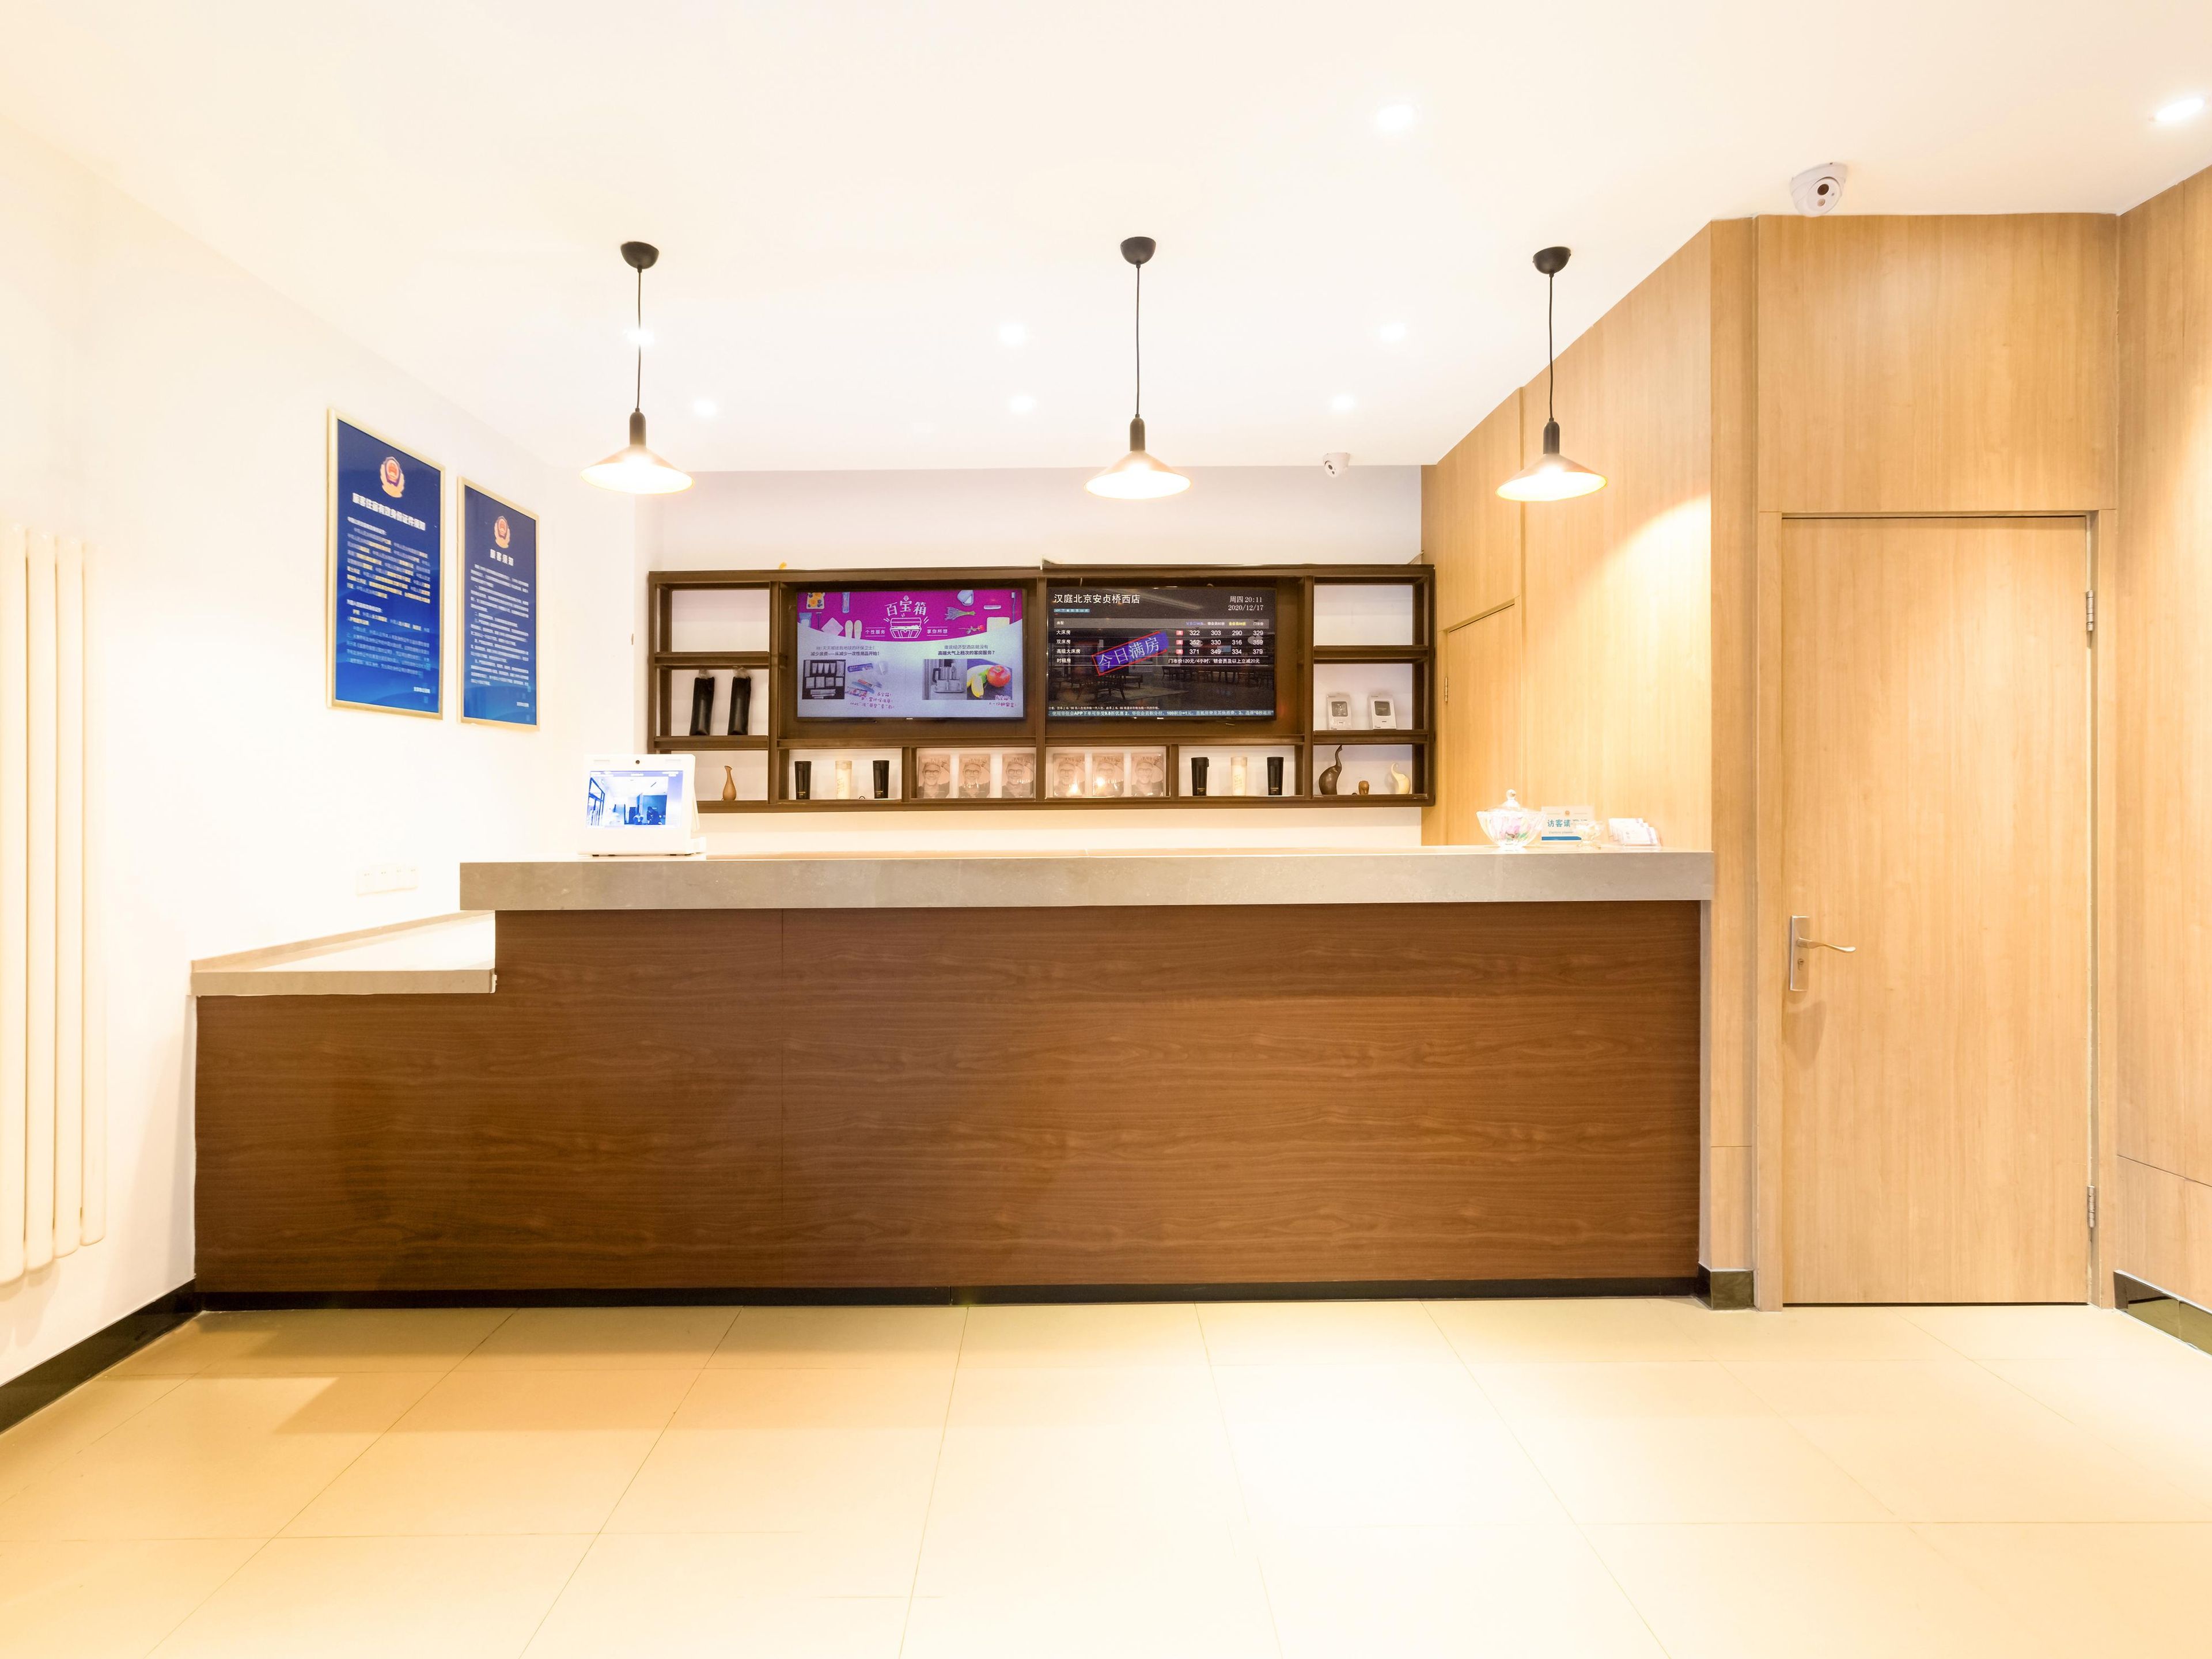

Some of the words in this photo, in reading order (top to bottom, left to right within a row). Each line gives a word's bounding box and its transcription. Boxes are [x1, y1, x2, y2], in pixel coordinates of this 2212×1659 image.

[1054, 594, 1141, 604] 汉庭北京安贞桥西店
[885, 600, 927, 616] 百宝箱
[1099, 637, 1159, 668] 今日满房
